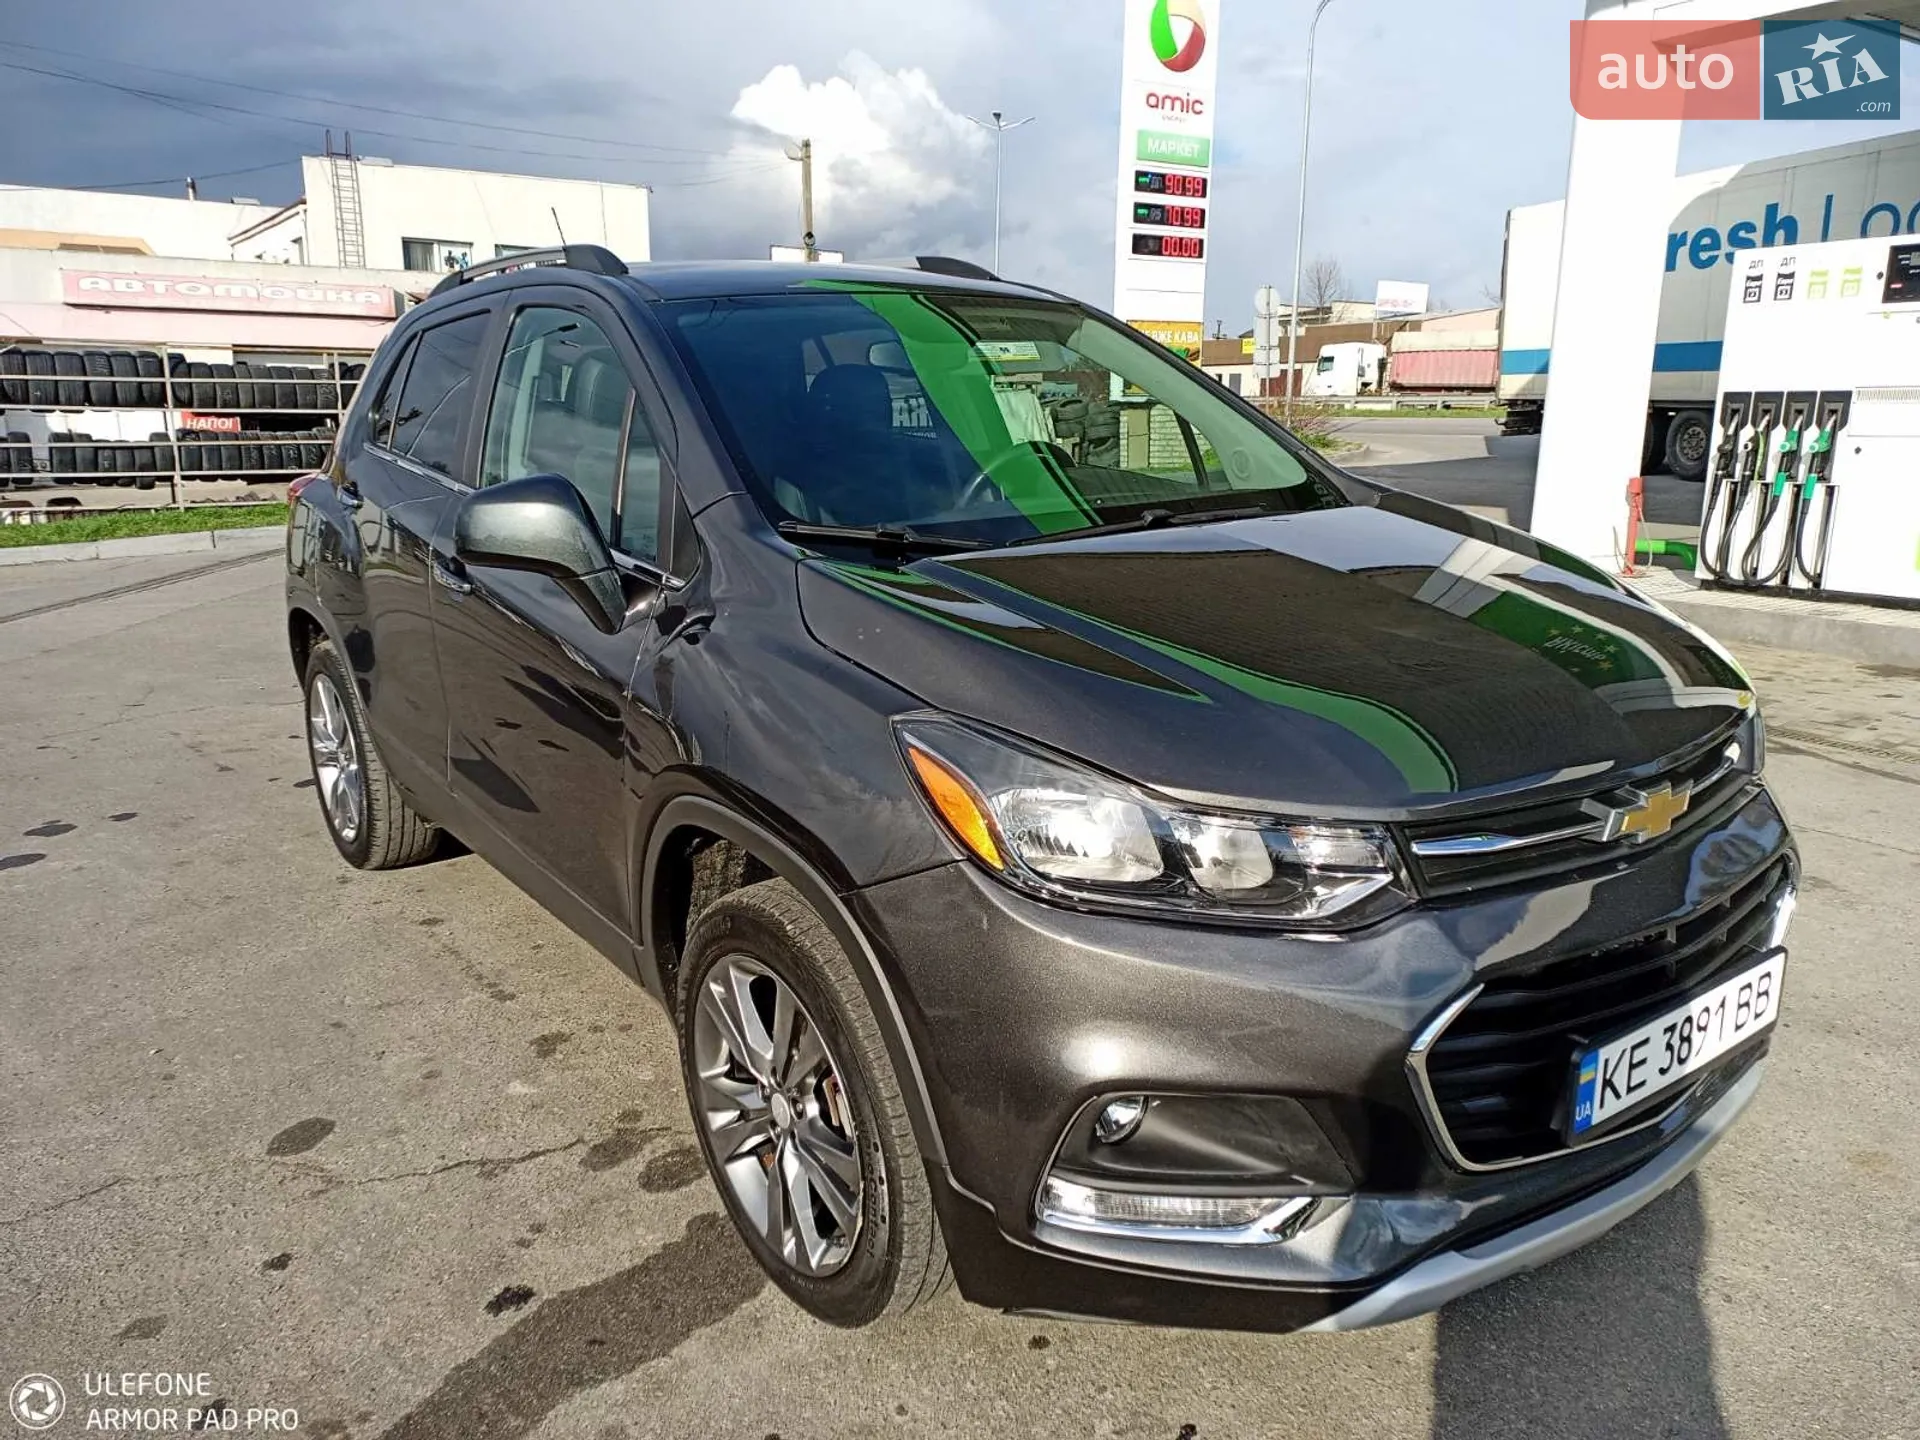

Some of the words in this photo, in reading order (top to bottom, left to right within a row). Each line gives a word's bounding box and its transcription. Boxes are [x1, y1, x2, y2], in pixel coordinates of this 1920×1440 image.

[1146, 92, 1204, 115] amic
[1147, 138, 1201, 158] МАРКЕТ
[1161, 236, 1199, 257] 00.00
[1665, 202, 1799, 272] resh
[1174, 330, 1199, 345] КАВА
[1599, 1036, 1650, 1111] KE
[1658, 995, 1727, 1077] 3891
[1734, 971, 1772, 1033] BB
[1575, 1101, 1591, 1121] UA
